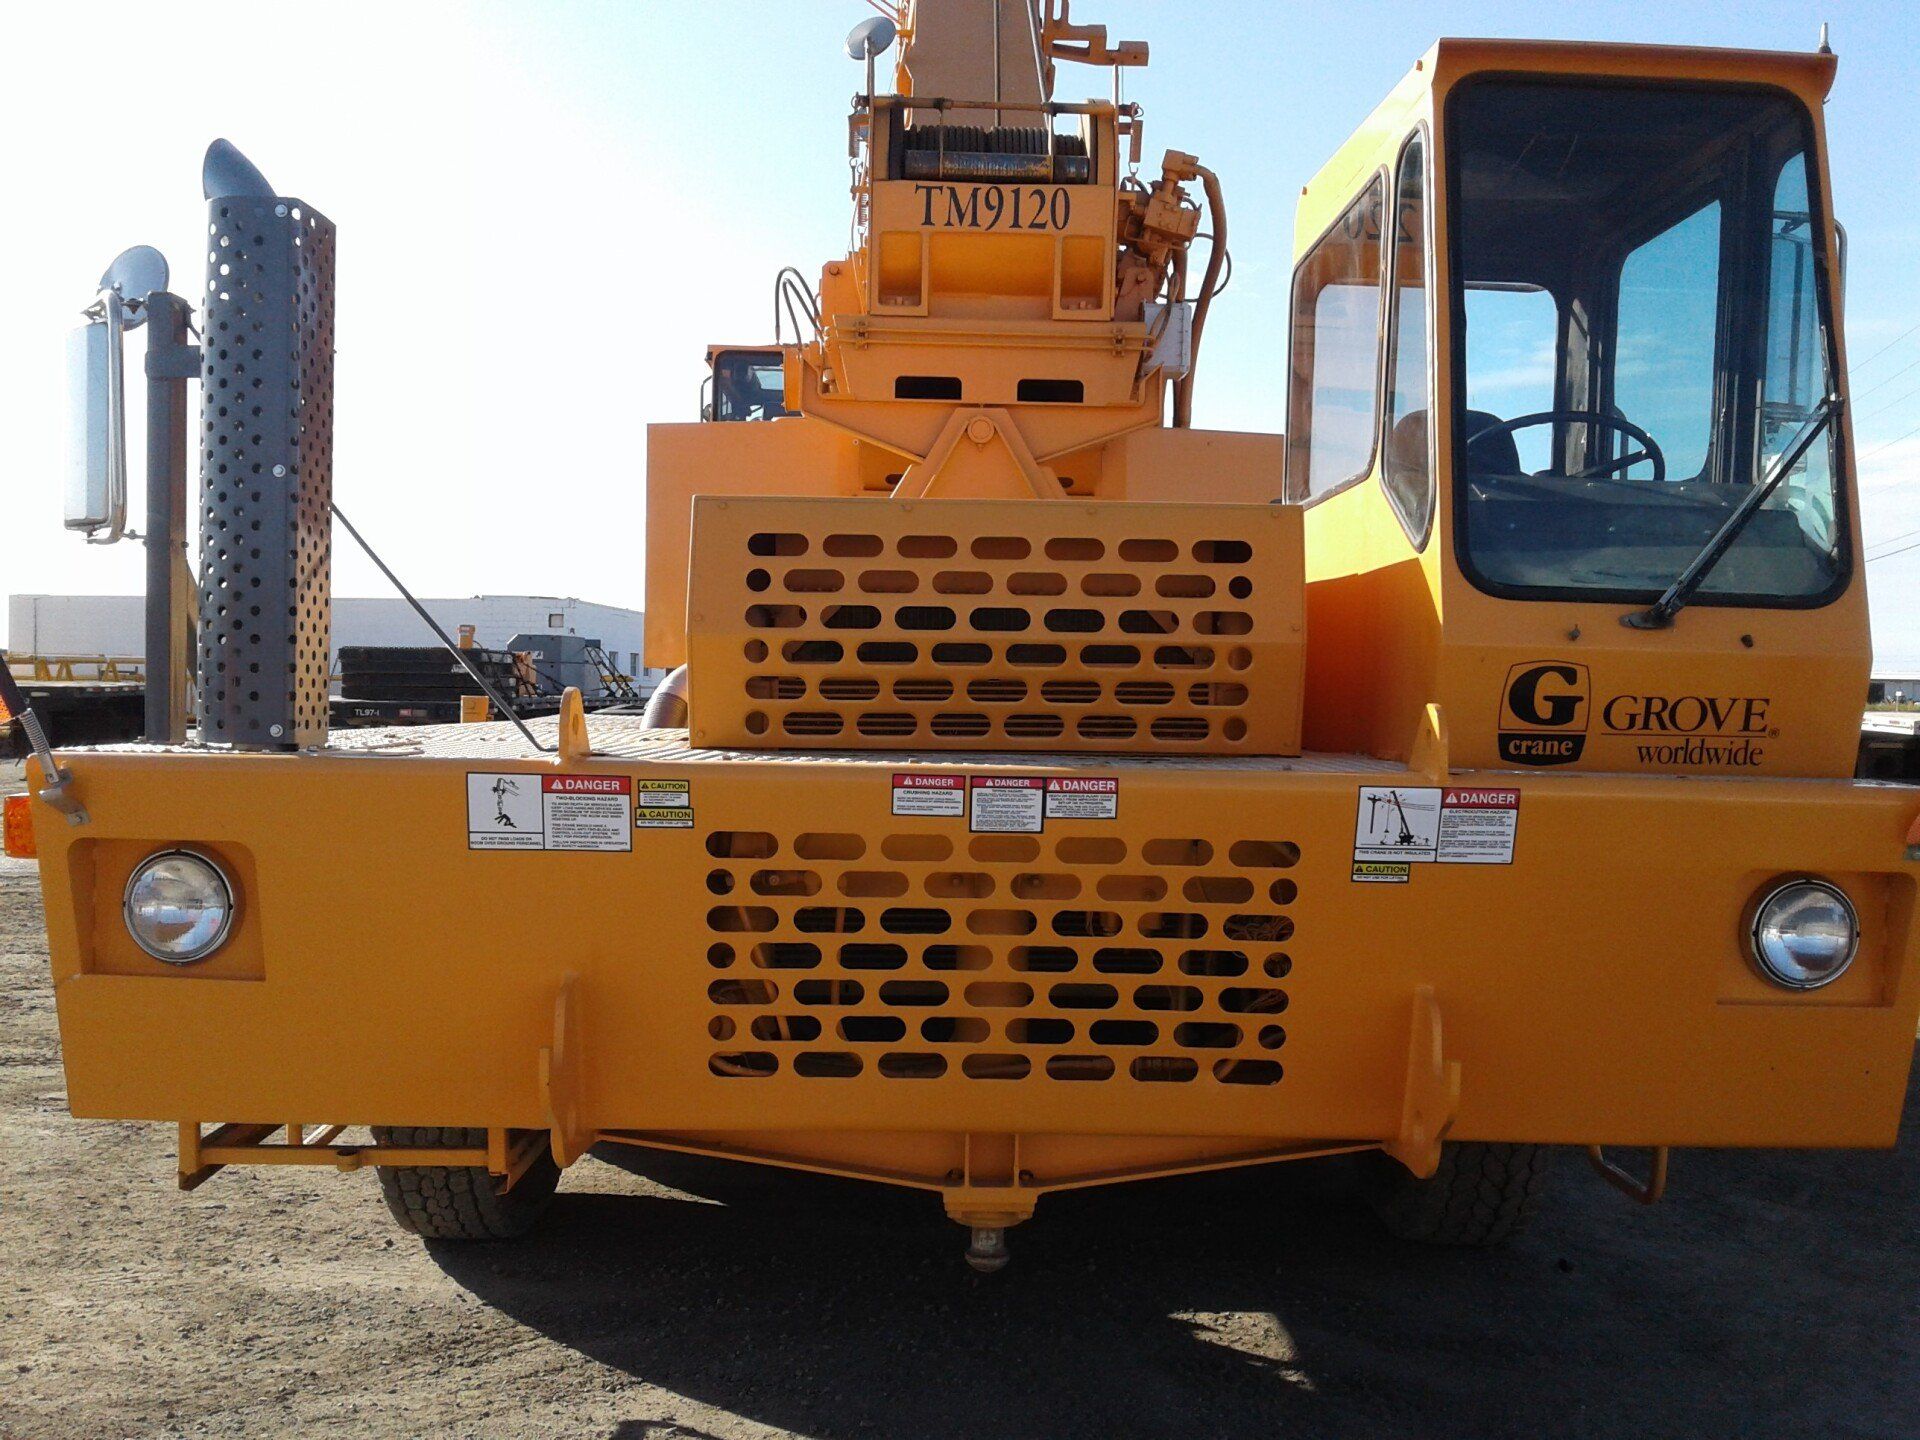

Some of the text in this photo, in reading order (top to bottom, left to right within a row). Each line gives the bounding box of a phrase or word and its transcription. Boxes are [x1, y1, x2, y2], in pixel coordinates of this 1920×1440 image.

[915, 182, 1070, 231] TM9120
[1602, 695, 1771, 733] GROVE
[1508, 739, 1574, 755] crane
[1637, 738, 1763, 766] worldwide
[565, 779, 620, 790] DANGER
[915, 778, 954, 786] DANGER
[994, 779, 1030, 787] DANGER
[1063, 780, 1116, 791] DANGER
[1460, 793, 1515, 804] DANGER
[648, 810, 691, 818] CAUTION
